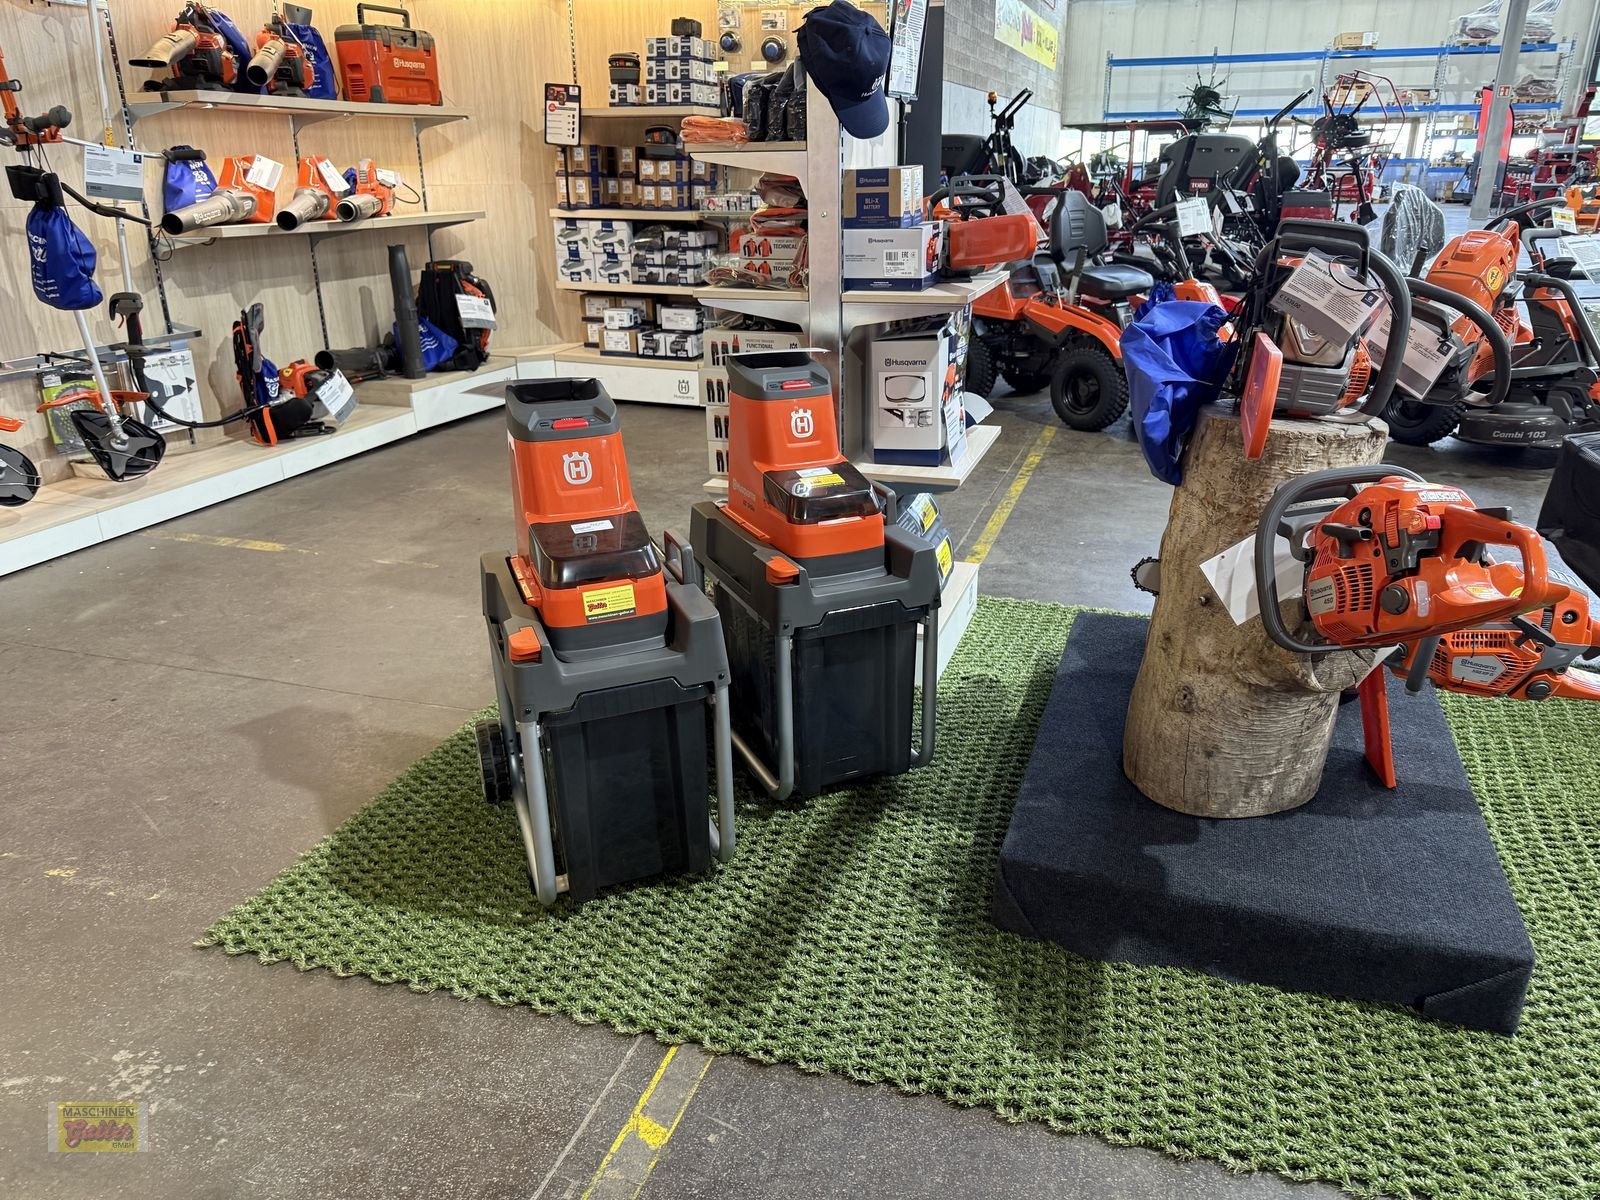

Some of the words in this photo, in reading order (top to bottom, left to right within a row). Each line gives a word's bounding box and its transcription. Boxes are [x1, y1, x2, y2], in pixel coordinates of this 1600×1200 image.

[892, 359, 927, 368] Husqvarna
[1492, 430, 1524, 439] Combi
[1527, 430, 1547, 439] 103
[1323, 597, 1334, 605] 450
[1466, 660, 1497, 671] Husqvarna
